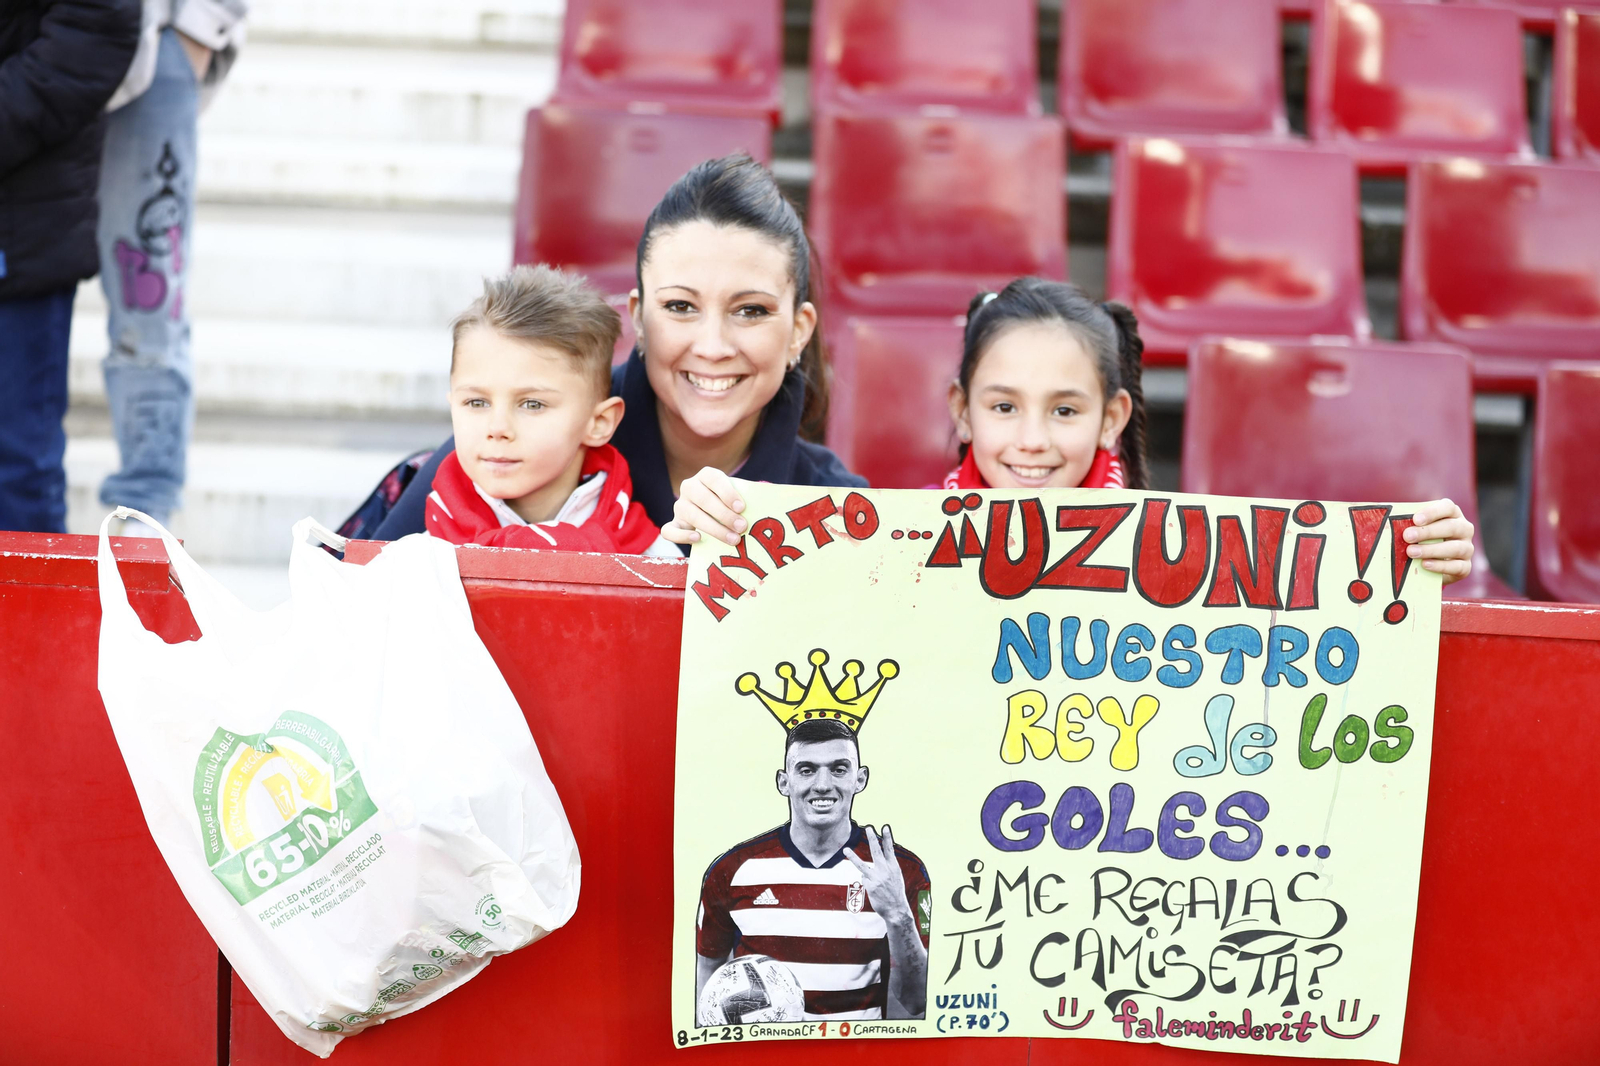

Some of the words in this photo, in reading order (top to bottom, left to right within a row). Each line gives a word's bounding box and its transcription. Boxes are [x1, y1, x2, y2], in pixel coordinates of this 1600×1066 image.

[992, 612, 1359, 688] NUESTRO
[202, 732, 235, 796] REUTILIZABLE
[1000, 689, 1160, 771] REY
[1173, 693, 1277, 777] de
[202, 804, 220, 854] REUSABLE
[229, 778, 243, 838] RECYCLABLE
[258, 893, 300, 922] RECYCLED
[299, 873, 331, 898] MATERIAL
[347, 832, 383, 867] RECICLADO
[270, 902, 310, 930] MATERIAL
[309, 885, 337, 911] RECICLAT
[354, 845, 387, 878] RECICLAT
[311, 893, 341, 919] MATERIAL
[1091, 866, 1347, 943] REGALAS
[485, 903, 502, 920] 50
[944, 920, 1005, 985] TU
[677, 1026, 744, 1046] 8-1-23
[1112, 999, 1318, 1043] faleminderit
